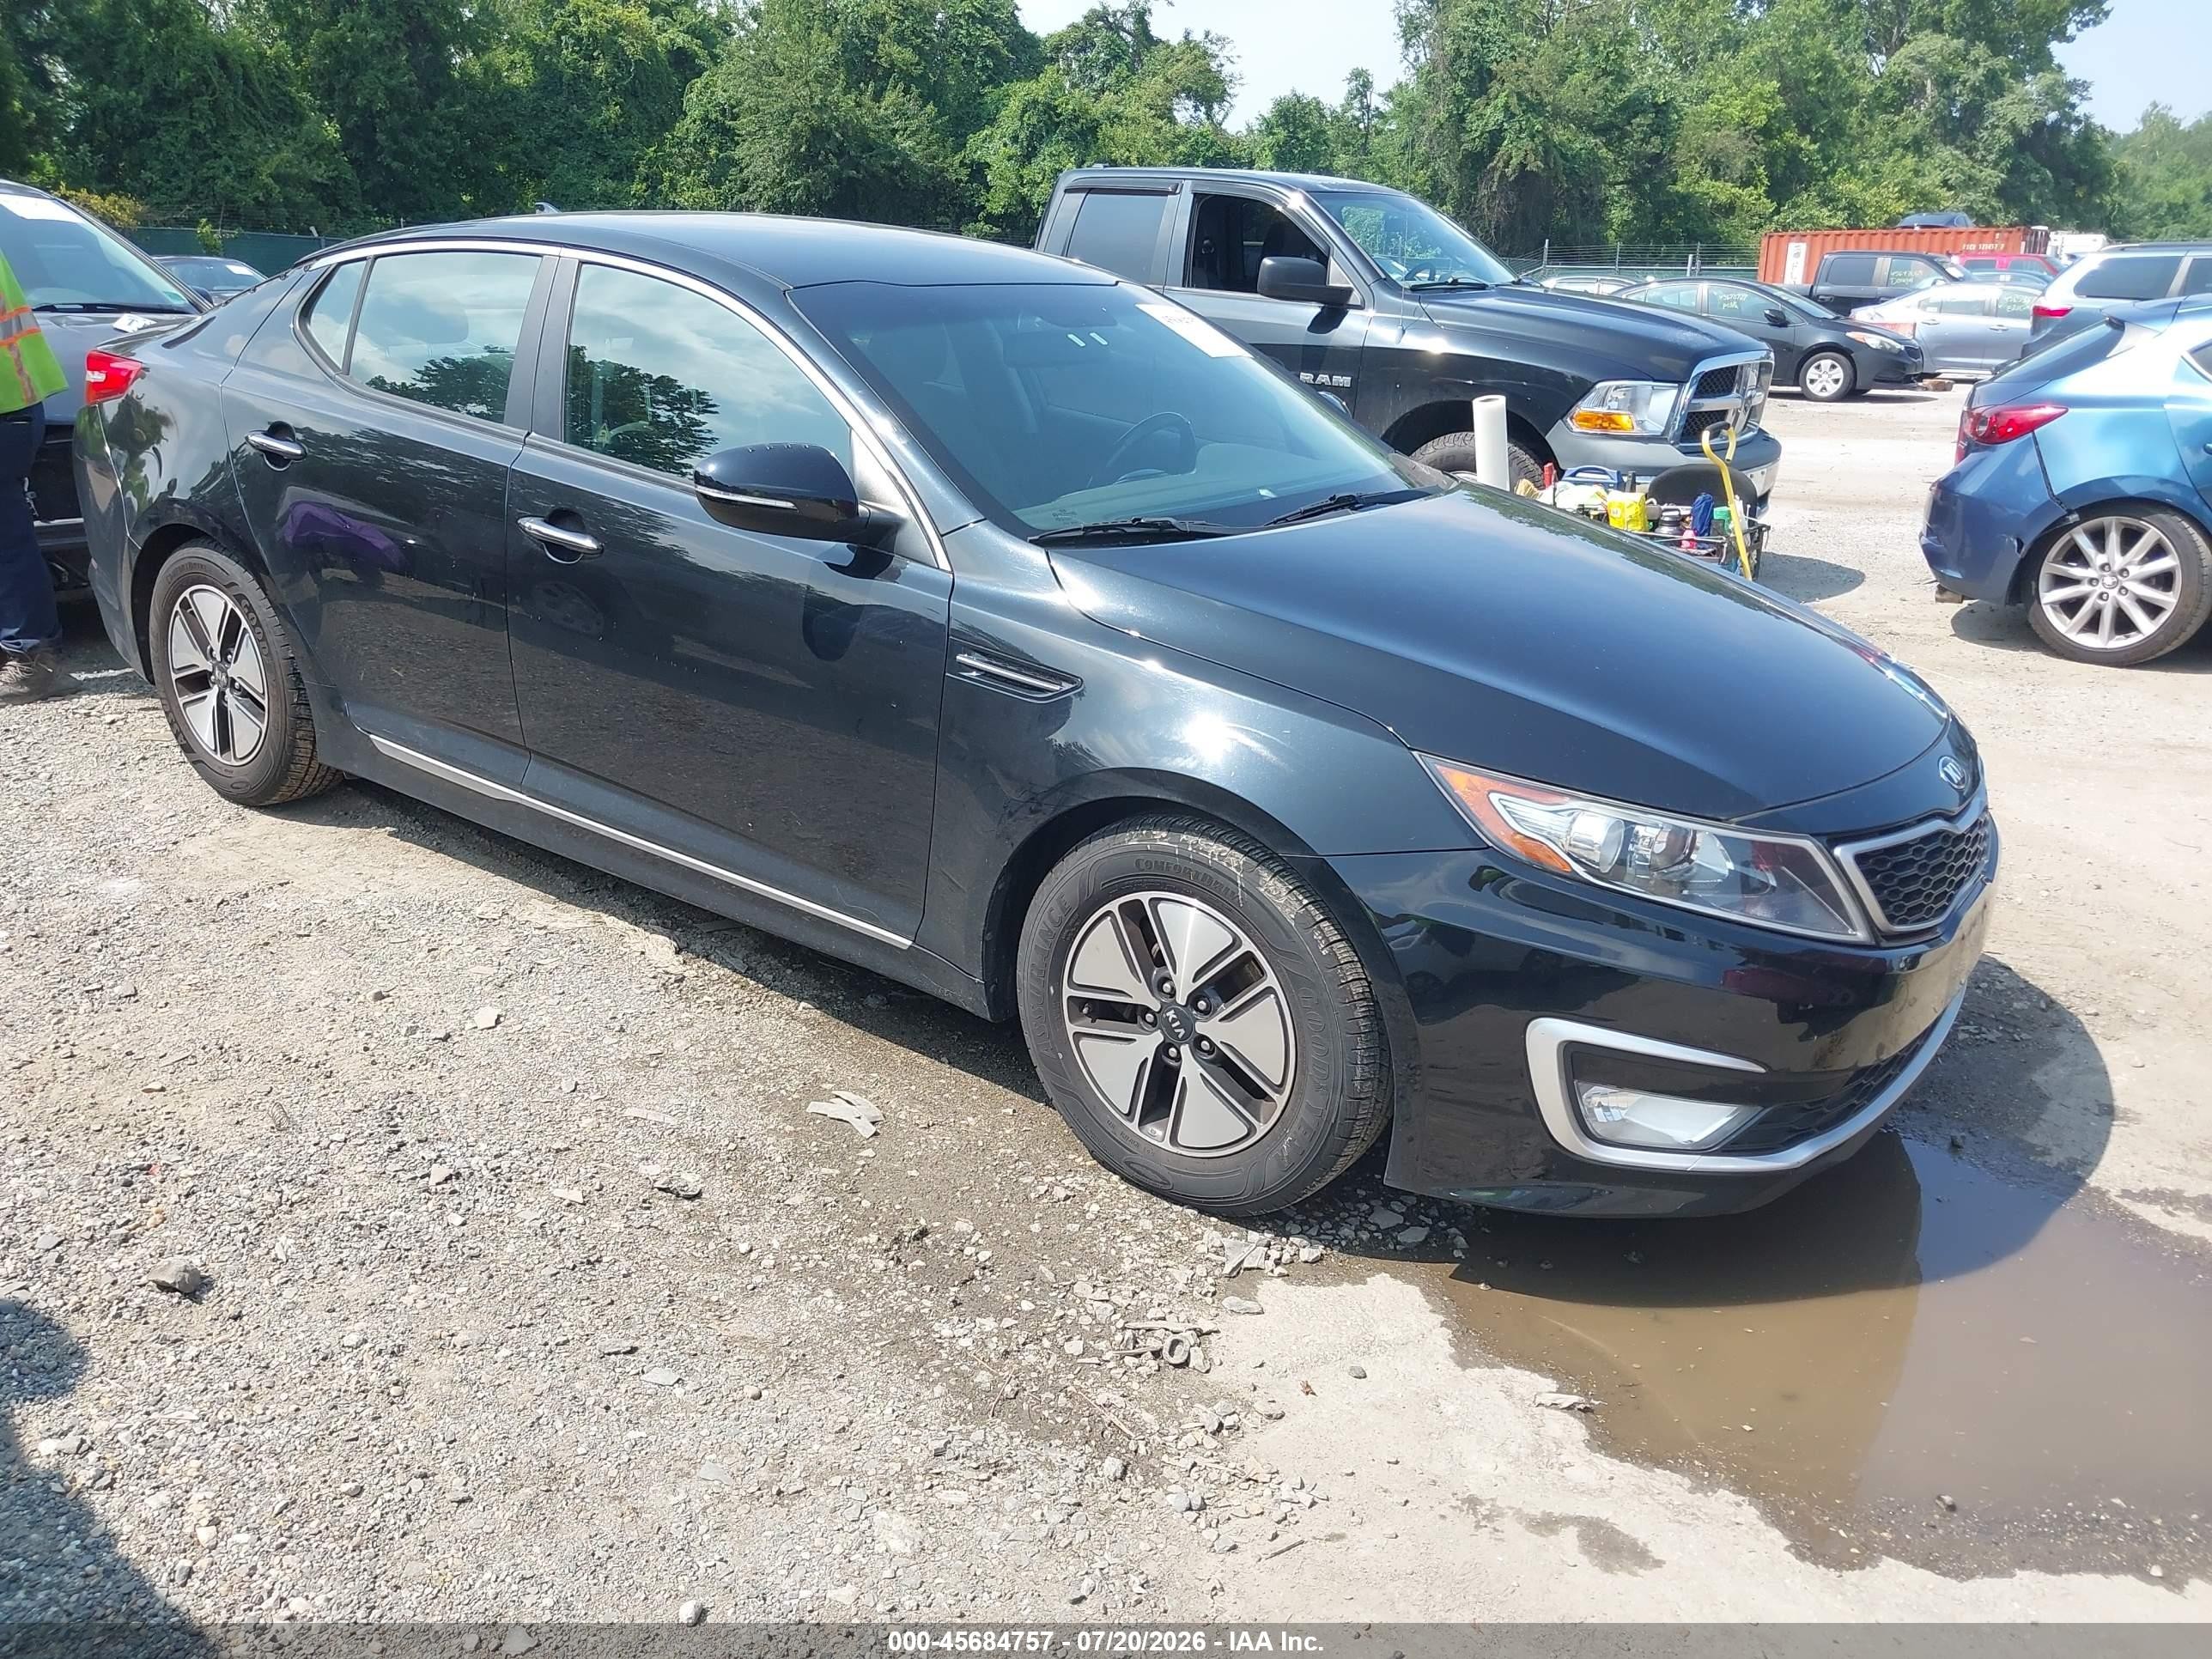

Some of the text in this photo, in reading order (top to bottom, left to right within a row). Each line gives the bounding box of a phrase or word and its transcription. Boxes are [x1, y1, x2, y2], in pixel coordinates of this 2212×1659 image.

[1299, 372, 1352, 387] RAM
[1029, 891, 1073, 1060] ASSURANCE
[1165, 1009, 1186, 1039] KIA
